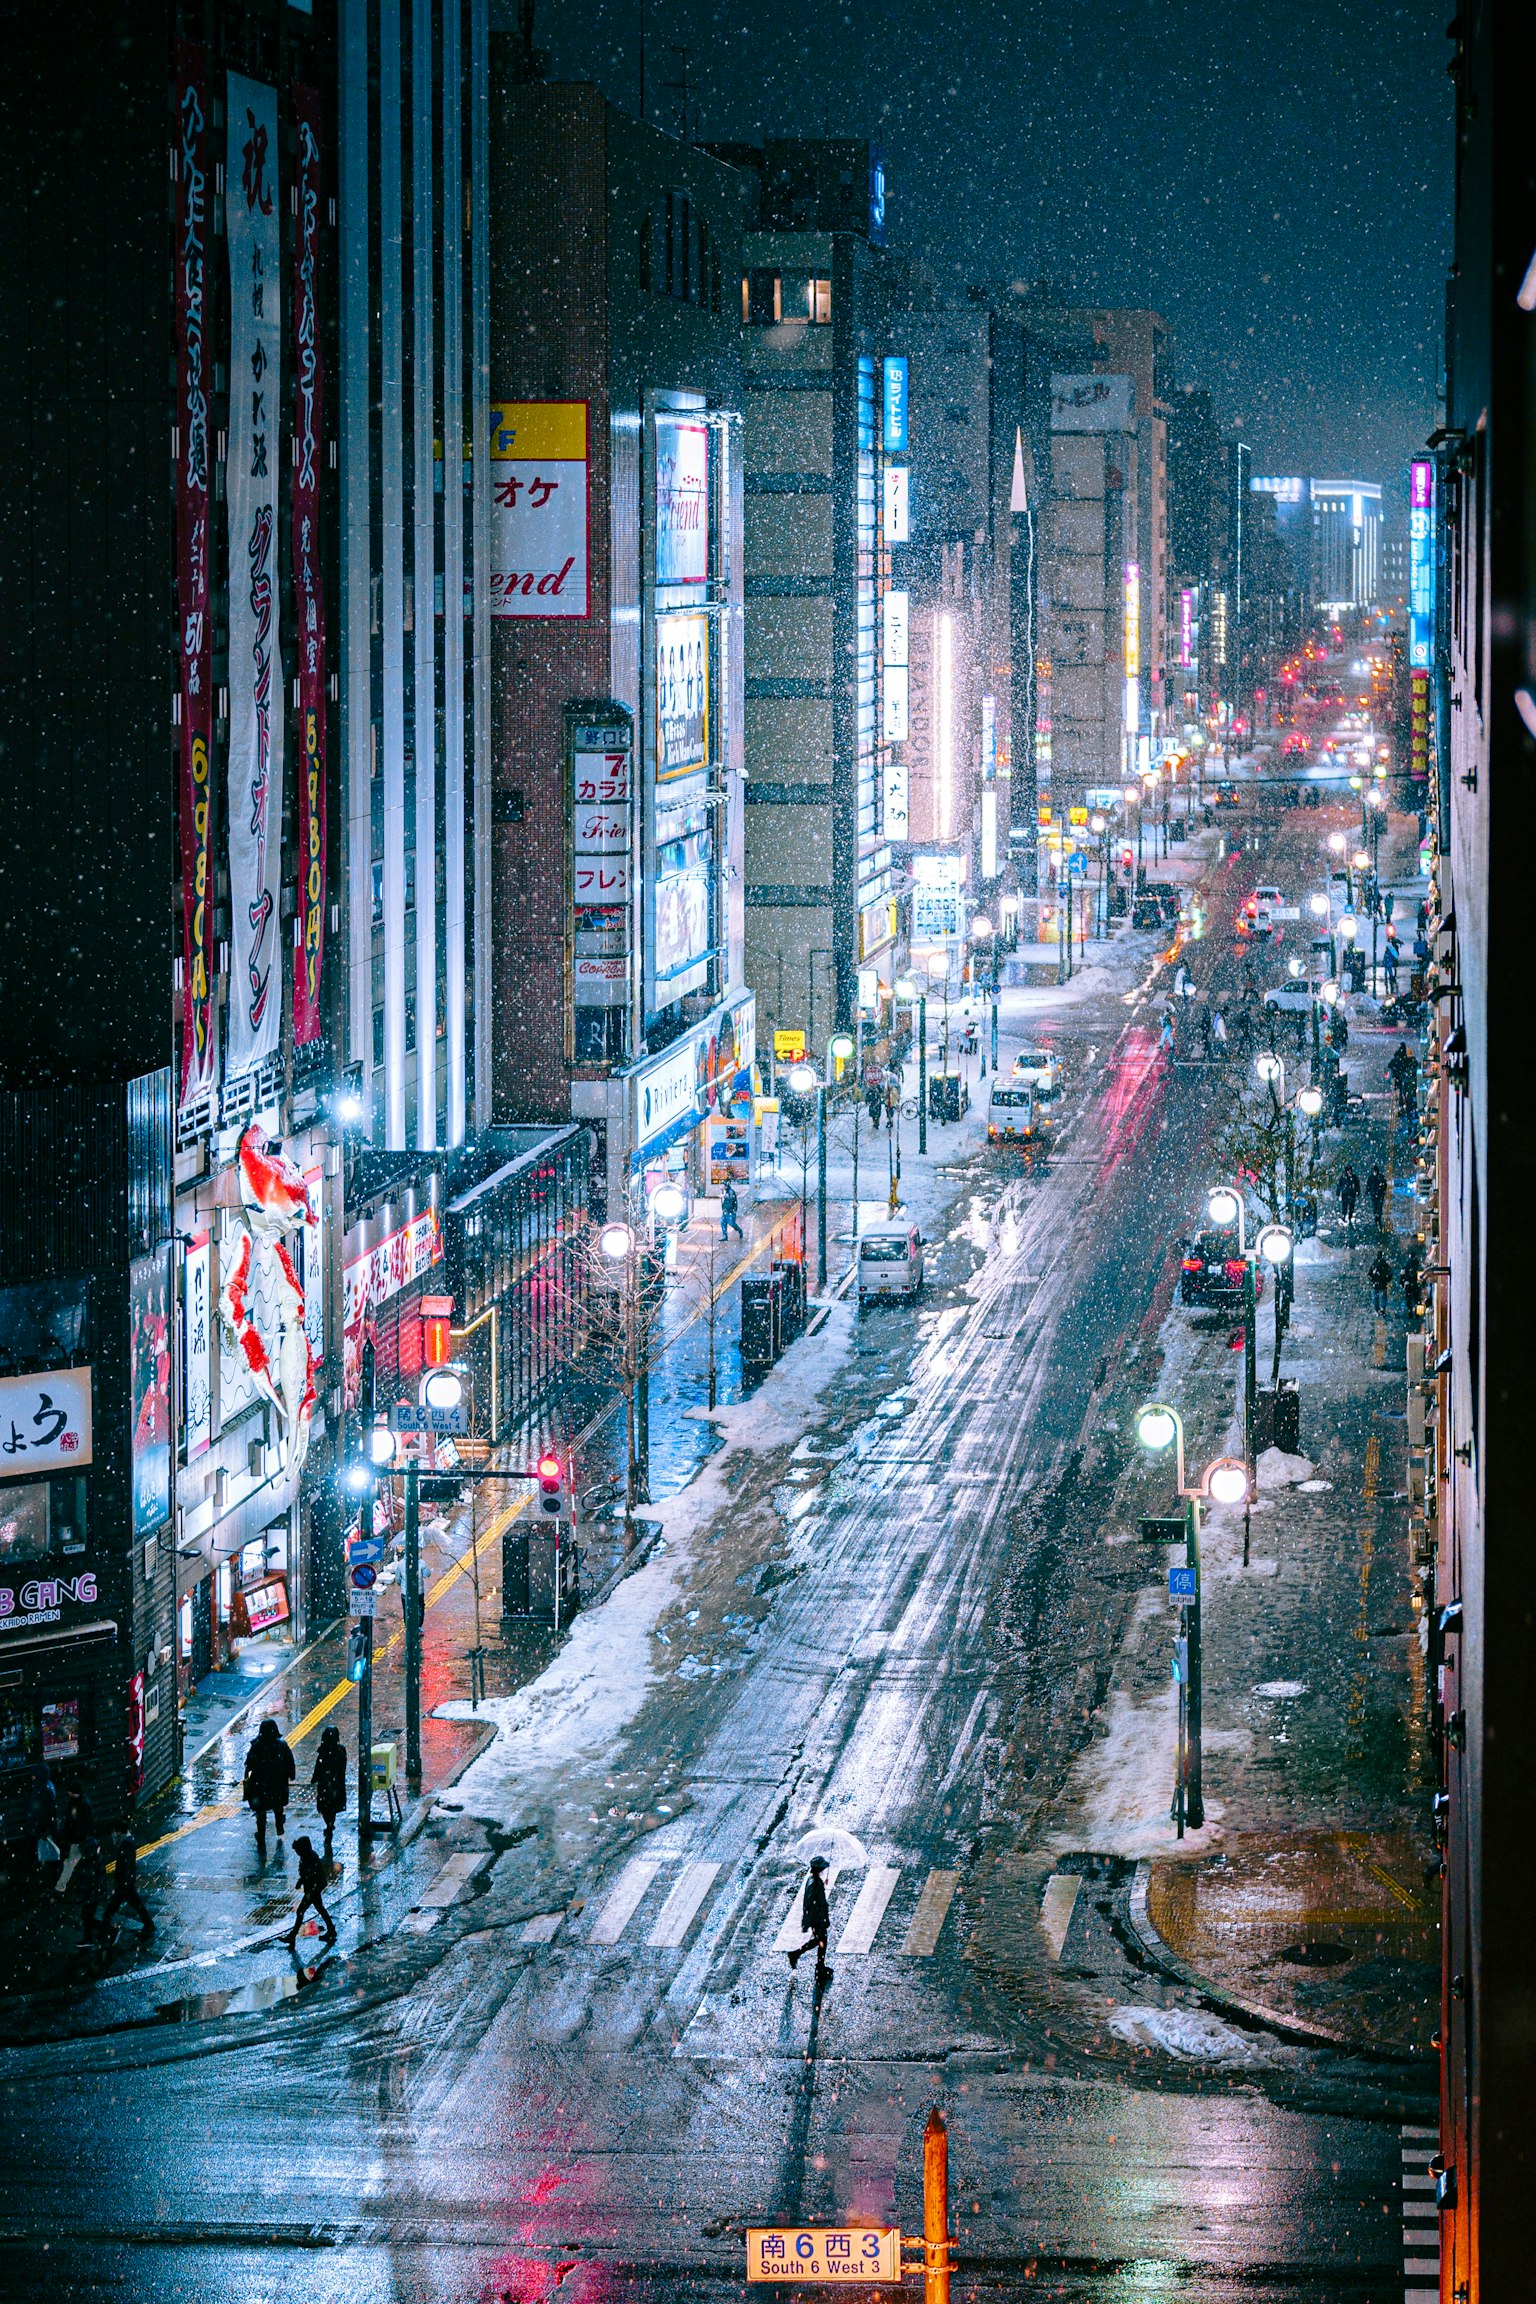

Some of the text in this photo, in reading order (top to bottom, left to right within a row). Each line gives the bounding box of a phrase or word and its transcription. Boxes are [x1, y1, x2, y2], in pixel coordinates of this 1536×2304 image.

[241, 106, 274, 217] 祝
[250, 242, 265, 321] 札幌
[248, 503, 274, 1031] グランドオープン
[778, 1034, 801, 1042] Times
[794, 1050, 804, 1060] P
[397, 1422, 460, 1430] South 6 West 4
[1173, 1572, 1192, 1590] 停
[20, 1572, 98, 1611] GANG
[26, 1608, 61, 1626] RAMEN
[761, 2260, 880, 2275] South 6 West 3
